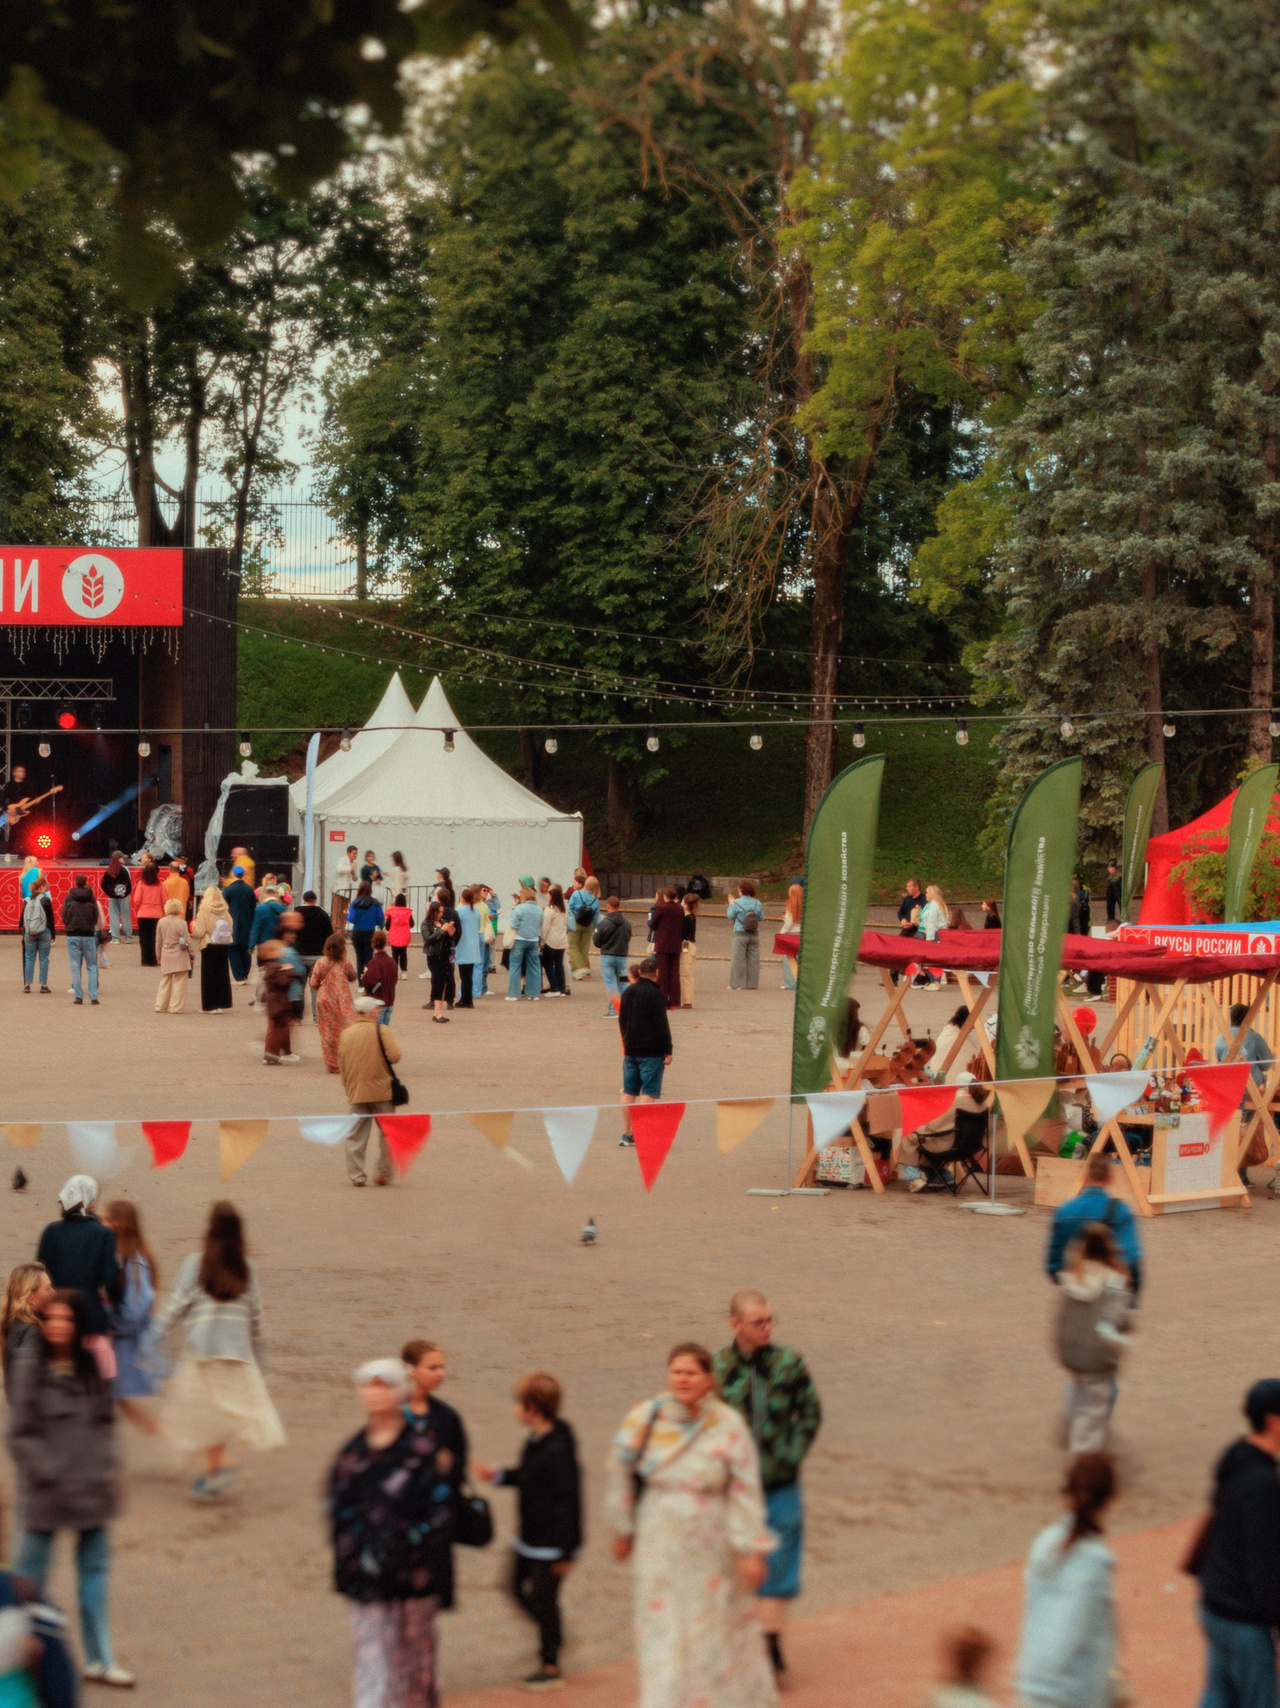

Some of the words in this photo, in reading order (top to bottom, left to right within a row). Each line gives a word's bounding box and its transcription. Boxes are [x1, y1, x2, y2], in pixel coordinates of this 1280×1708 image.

[840, 831, 848, 882] хозяйства
[836, 883, 848, 934] сельского
[1154, 935, 1192, 952] ВКУСЫ
[1195, 937, 1242, 955] РОССИИ
[820, 936, 842, 1008] Министерство
